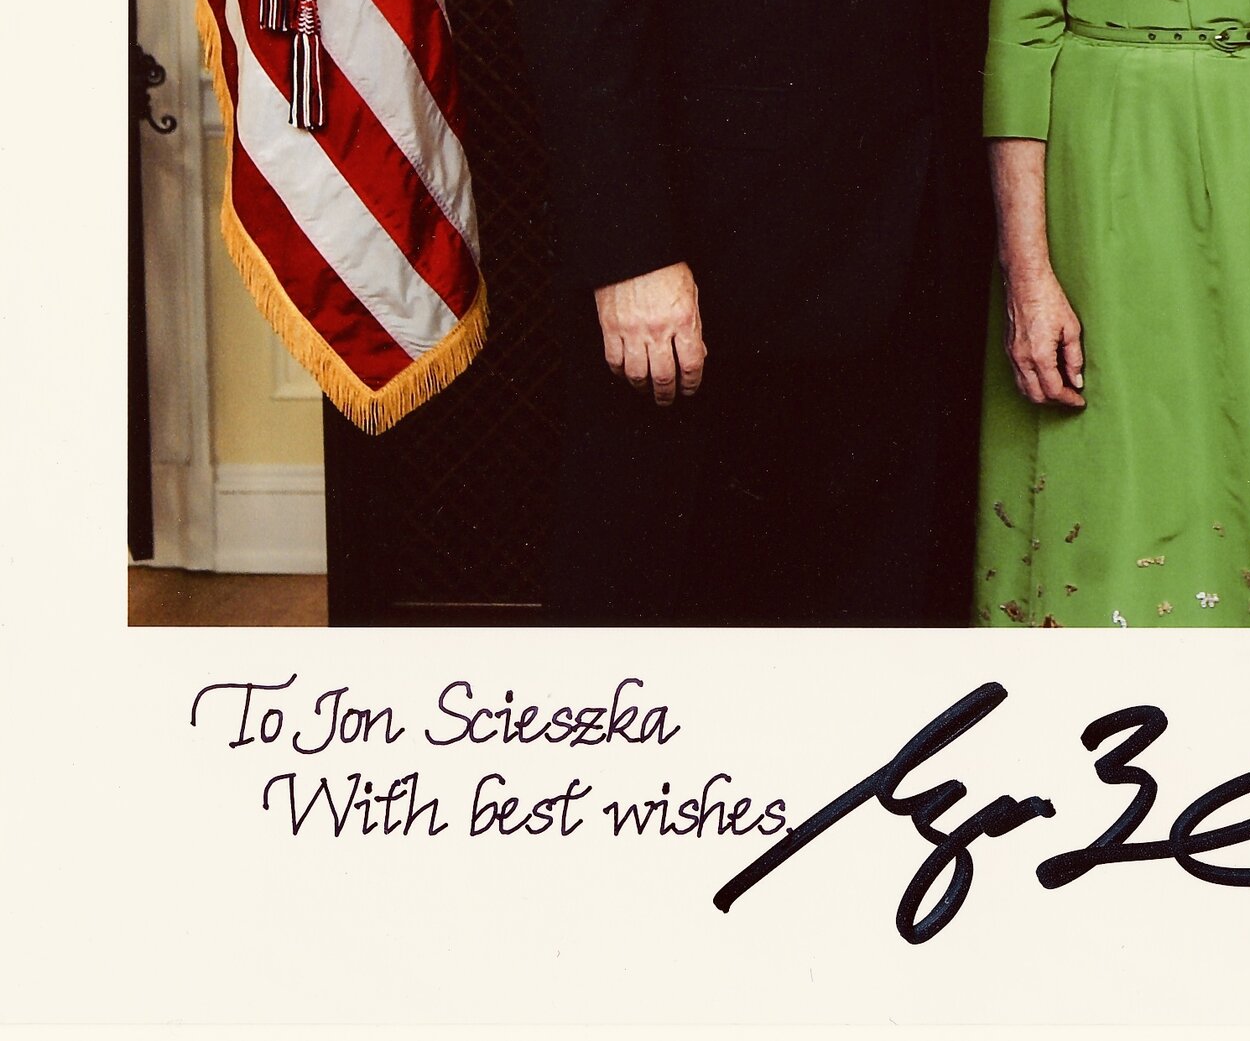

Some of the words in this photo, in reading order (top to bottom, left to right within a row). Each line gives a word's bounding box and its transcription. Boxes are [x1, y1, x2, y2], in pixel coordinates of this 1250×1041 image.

[190, 673, 298, 749] To
[292, 686, 406, 755] Jon
[424, 677, 681, 748] Scieszka
[262, 772, 449, 838] With
[469, 772, 593, 837] best
